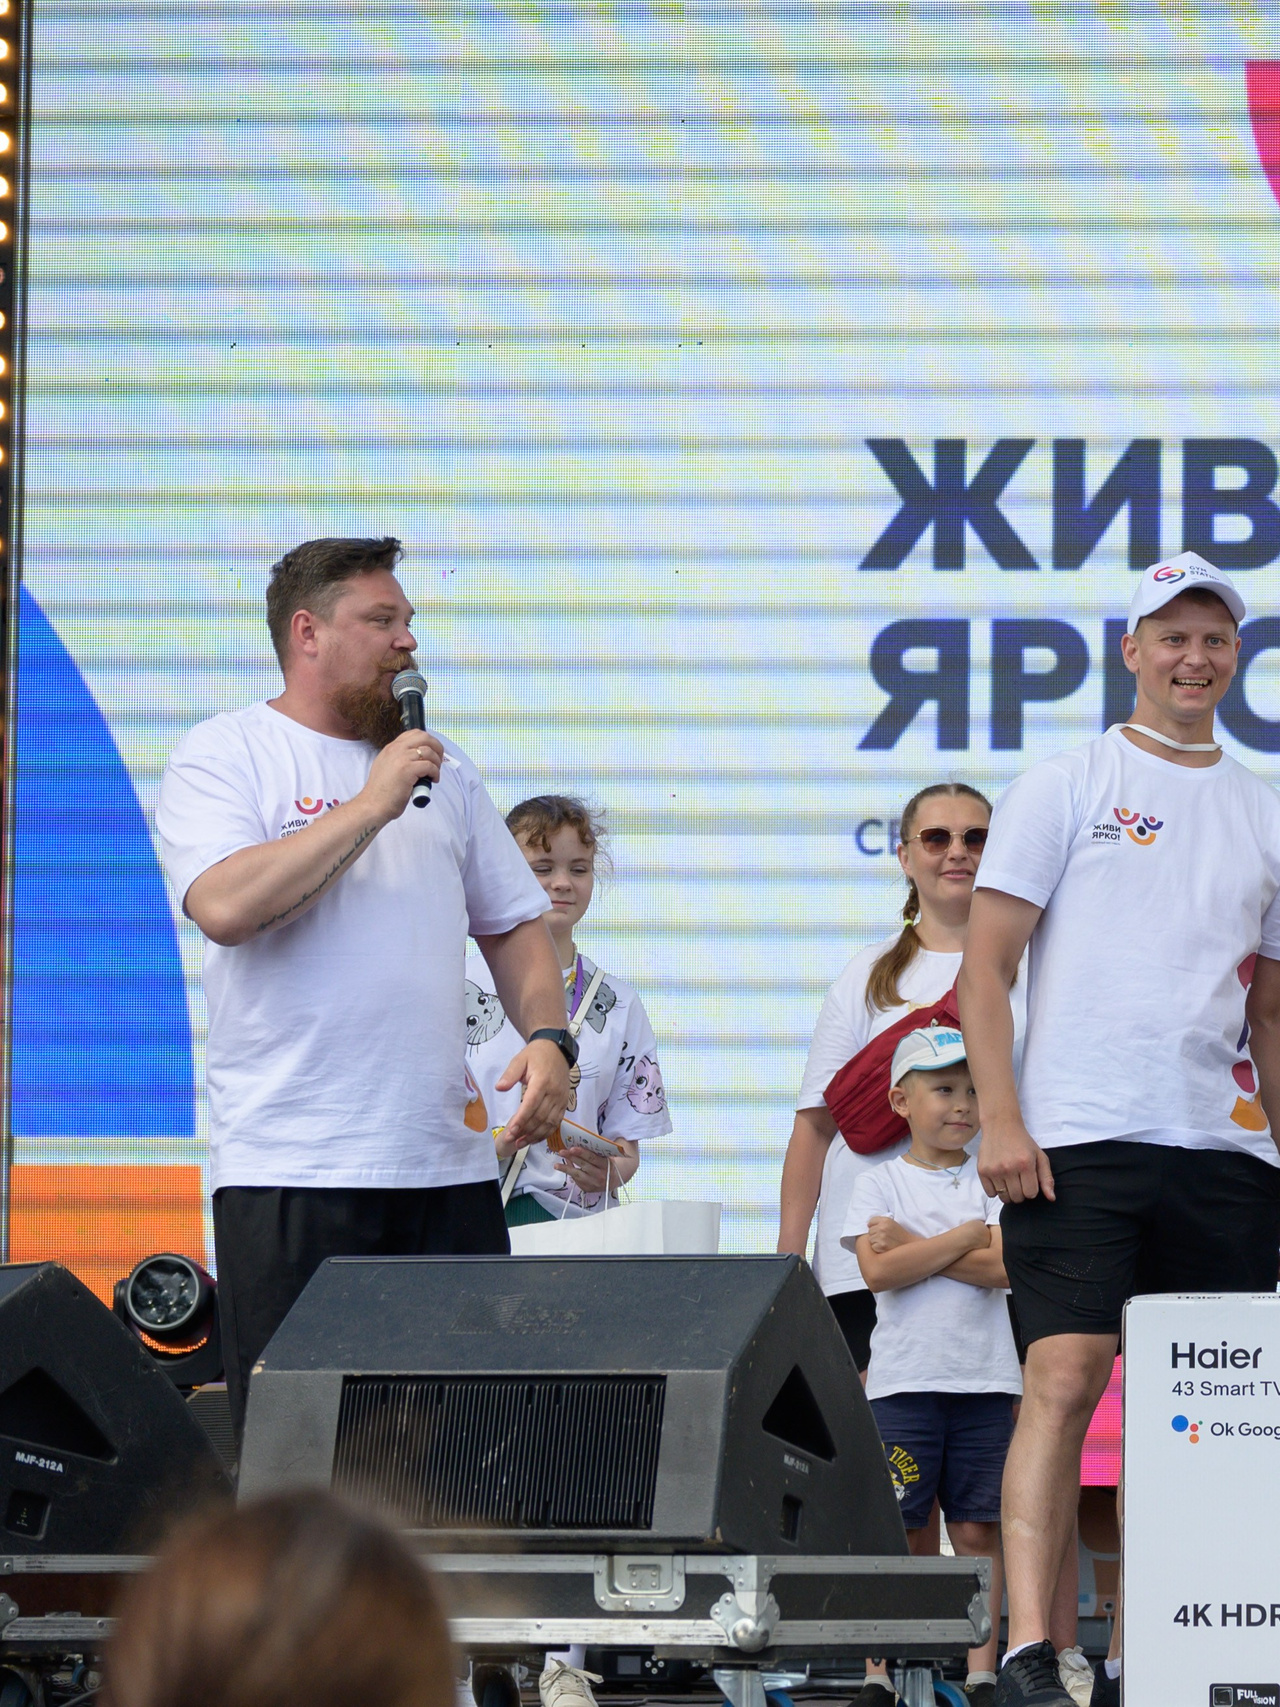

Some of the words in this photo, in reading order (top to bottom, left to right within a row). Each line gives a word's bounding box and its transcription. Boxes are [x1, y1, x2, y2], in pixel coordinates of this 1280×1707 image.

[1093, 823, 1121, 833] ЖИВИ
[1091, 832, 1121, 841] ЯРКО!
[1171, 1341, 1263, 1370] Haier
[1172, 1381, 1194, 1397] 43
[1200, 1381, 1255, 1397] Smart
[1210, 1422, 1234, 1437] Ok
[15, 1451, 64, 1473] MJF-212A
[889, 1446, 920, 1485] TIGER
[1173, 1604, 1211, 1627] 4K
[1237, 1689, 1258, 1700] FULL
